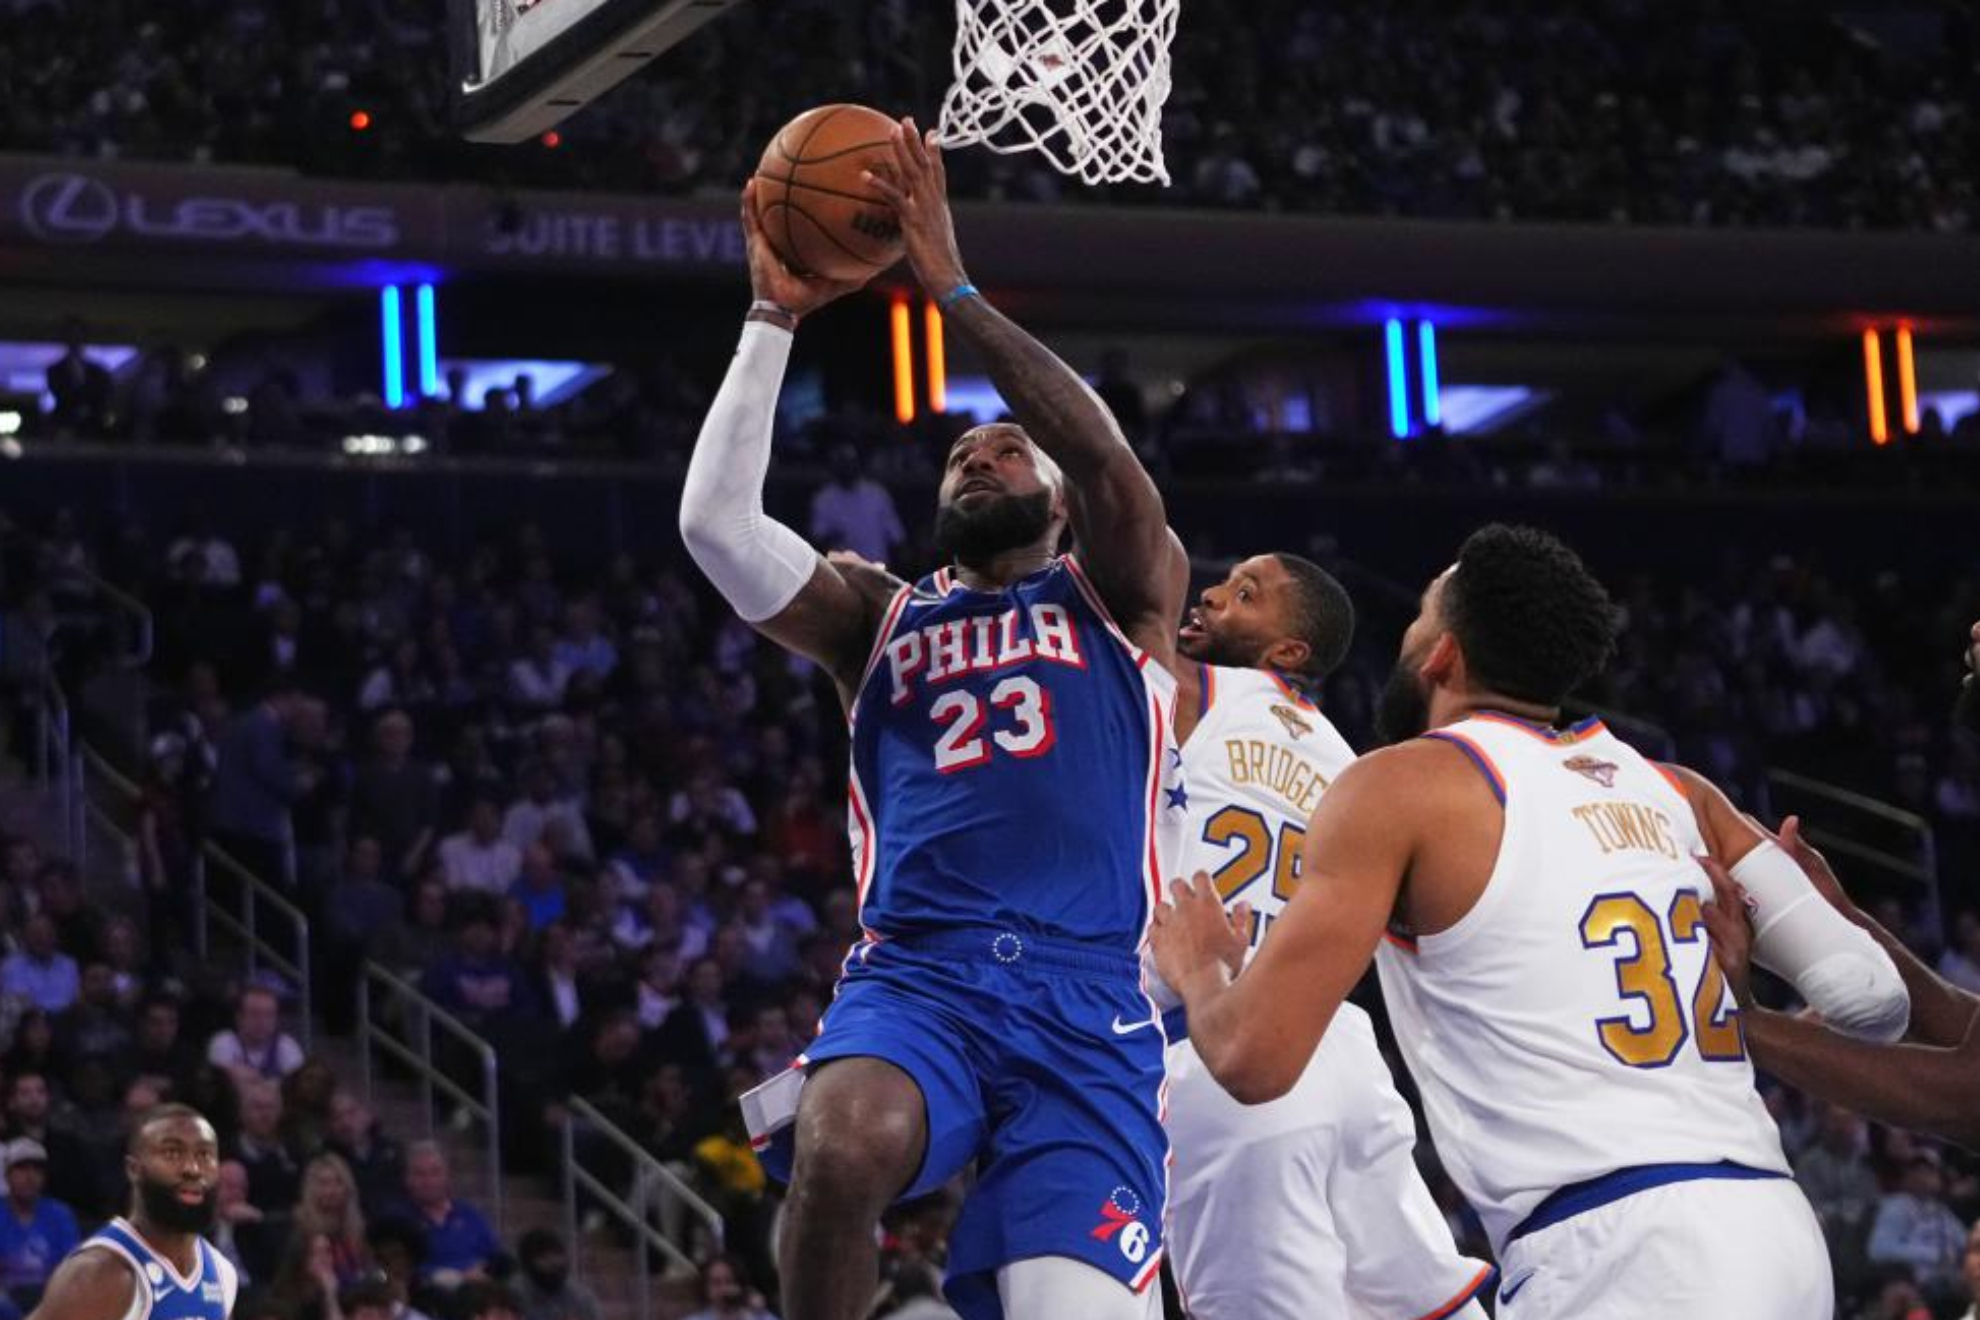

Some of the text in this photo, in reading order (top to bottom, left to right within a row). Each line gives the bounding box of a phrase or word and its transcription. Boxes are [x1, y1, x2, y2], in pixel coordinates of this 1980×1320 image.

[126, 192, 399, 248] LEXUS
[886, 603, 1088, 708] PHILA
[929, 675, 1057, 774] 23
[1571, 801, 1679, 860] TOWNS
[1578, 888, 1747, 1070] 32
